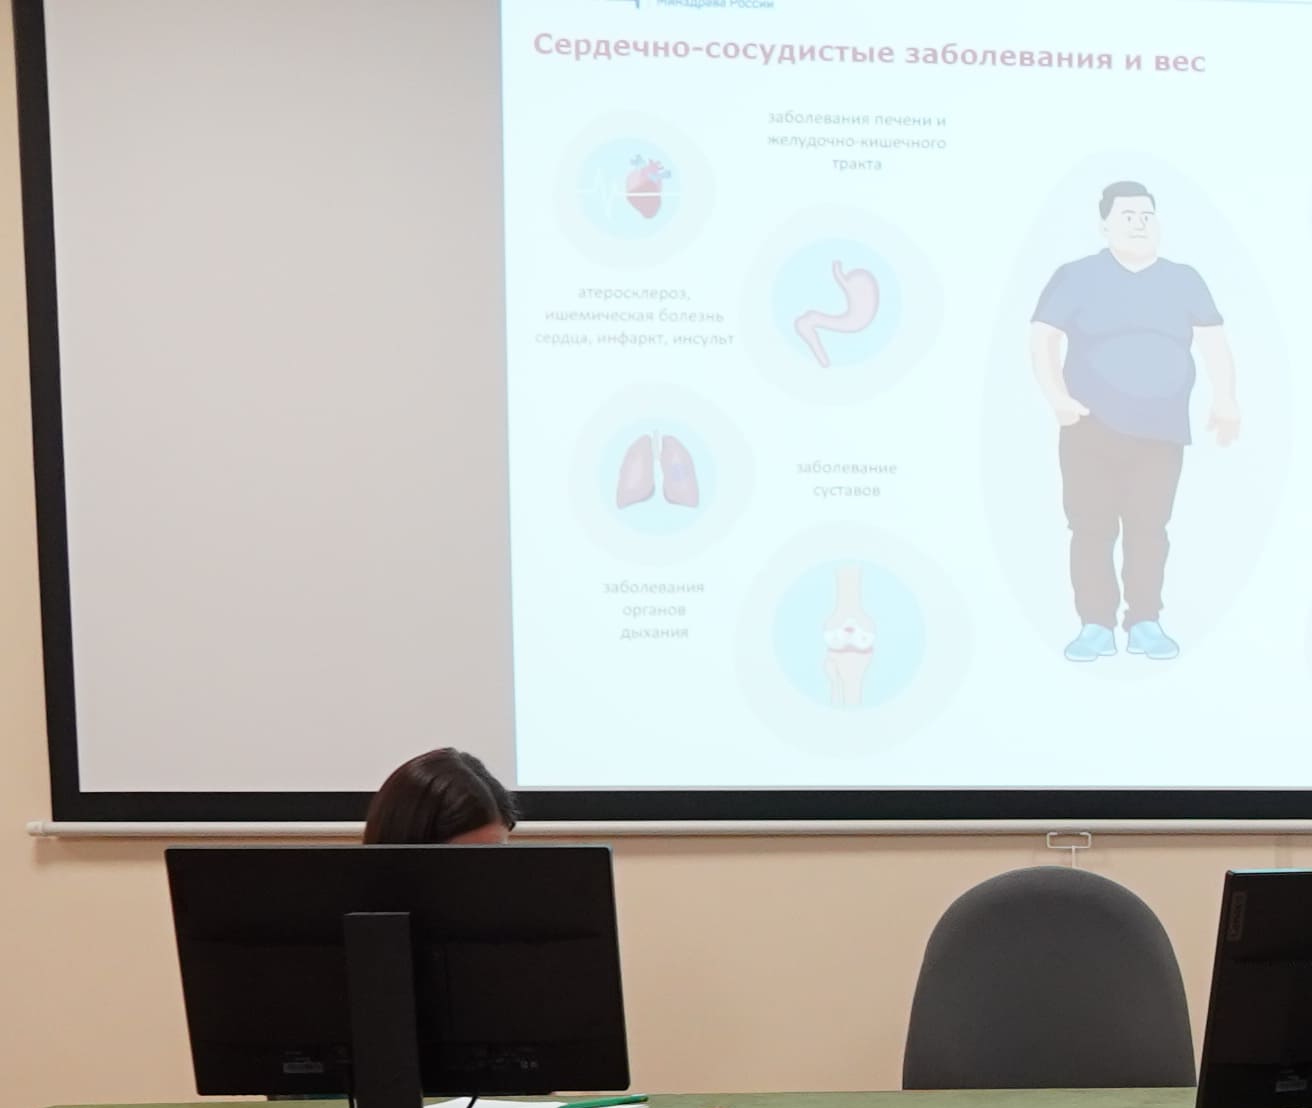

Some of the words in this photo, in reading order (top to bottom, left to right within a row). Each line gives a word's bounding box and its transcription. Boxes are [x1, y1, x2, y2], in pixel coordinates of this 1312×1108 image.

[533, 32, 895, 65] Сердечно-сосудистые
[905, 43, 1112, 68] заболевания
[1124, 54, 1142, 70] и
[1154, 54, 1206, 72] вес
[768, 110, 870, 126] заболевания
[874, 114, 932, 127] печени
[936, 117, 947, 127] и
[767, 135, 947, 149] желудочно-кишечного
[832, 158, 882, 171] тракта
[577, 287, 691, 301] атеросклероз,
[545, 310, 654, 321] ишемическая
[658, 308, 724, 322] болезнь
[597, 331, 668, 346] инфаркт,
[673, 335, 735, 348] инсульт
[796, 459, 898, 473] заболевание
[813, 485, 881, 499] суставов
[602, 580, 705, 593] заболевания
[622, 604, 687, 619] органов
[619, 627, 689, 640] дыхания
